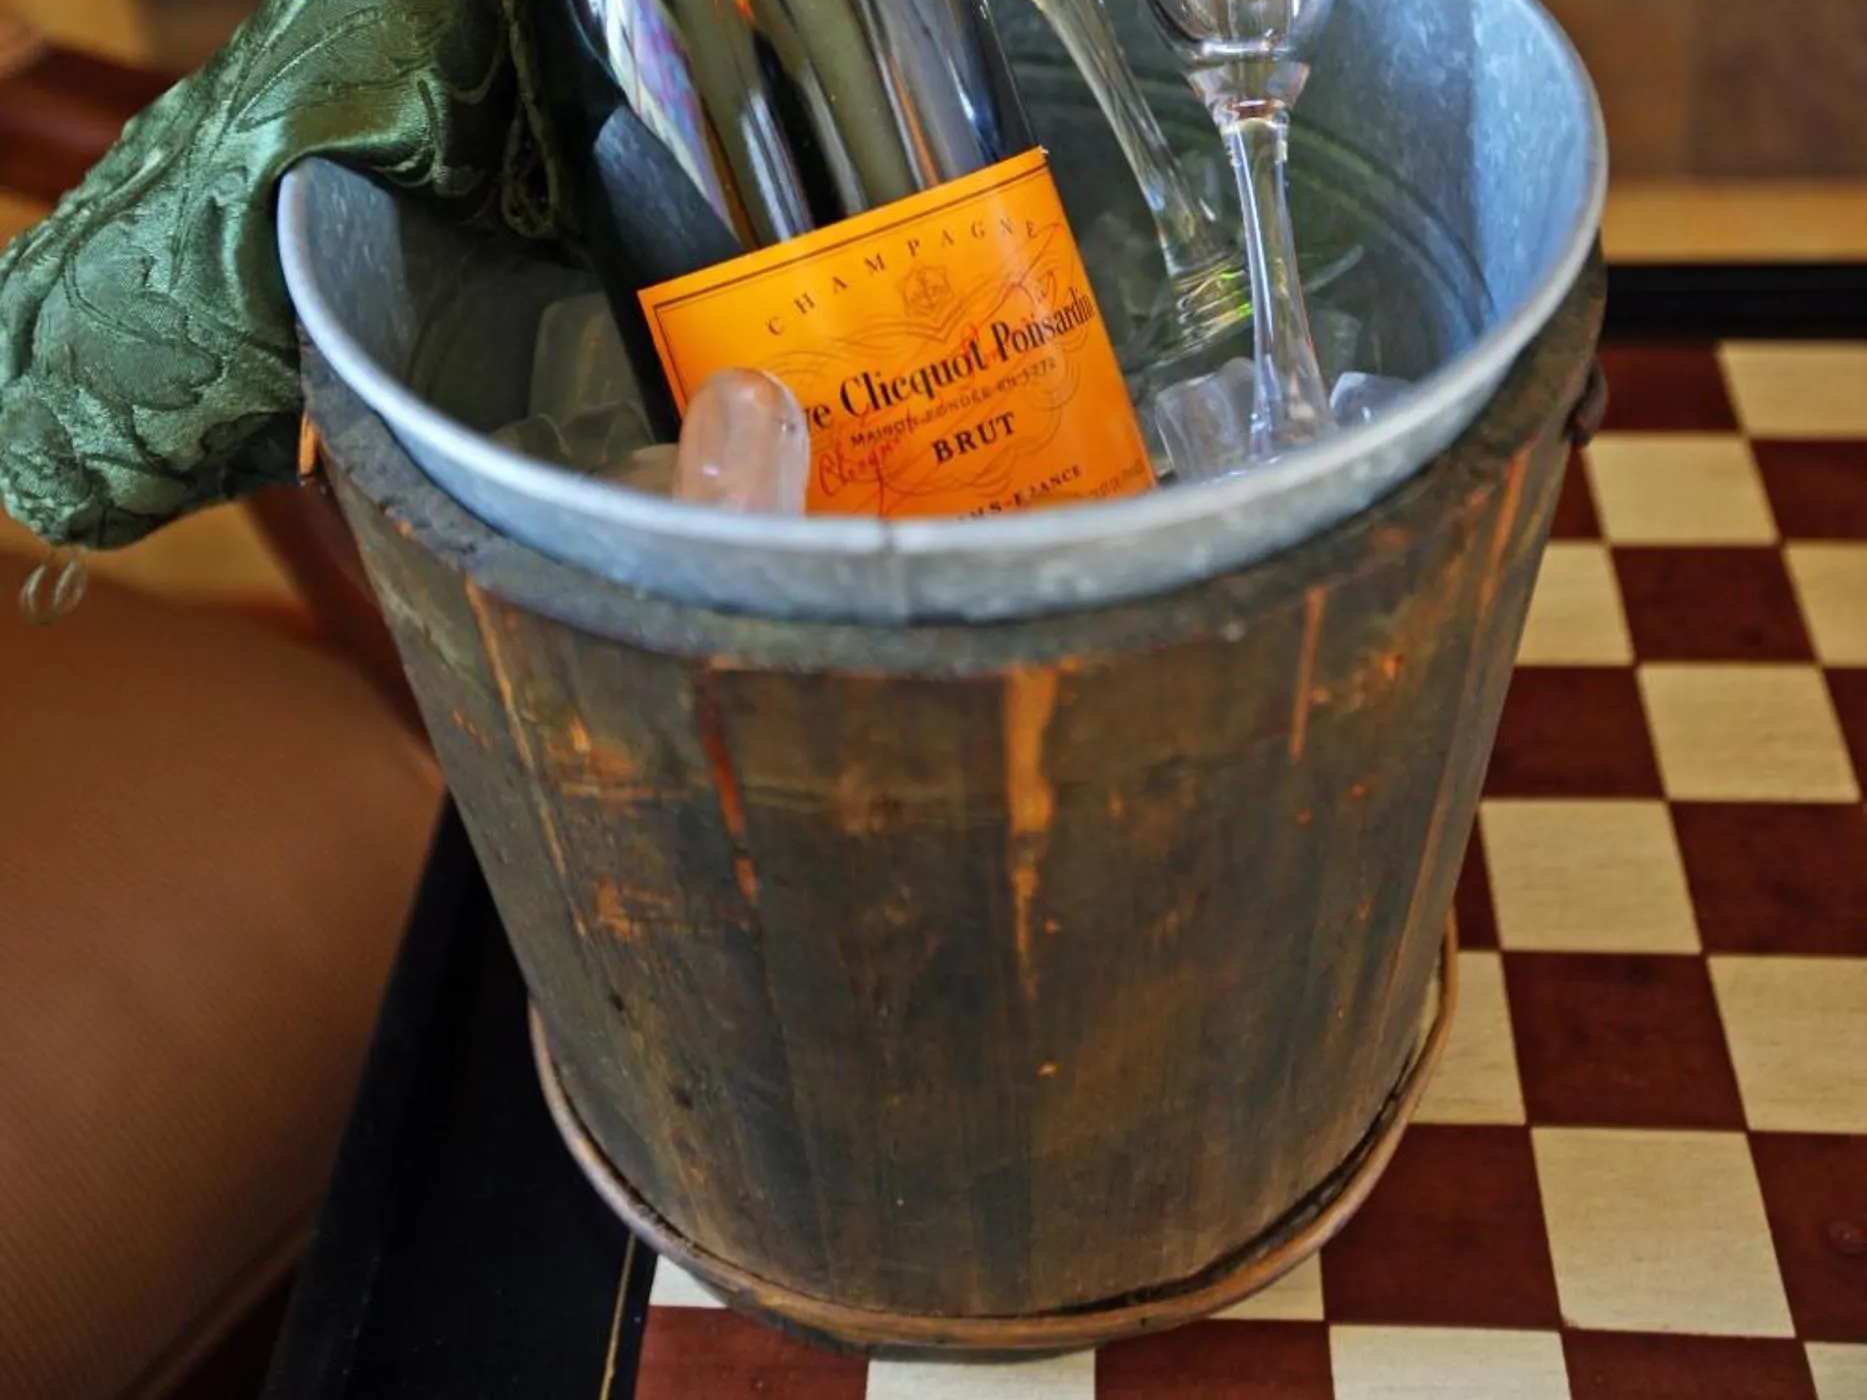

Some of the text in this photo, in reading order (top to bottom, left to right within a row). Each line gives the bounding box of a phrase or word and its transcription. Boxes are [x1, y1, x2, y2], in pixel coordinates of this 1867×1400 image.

[766, 218, 1037, 336] CHAMPAGNE
[840, 338, 988, 418] Clicquot
[931, 412, 1017, 464] BRUT
